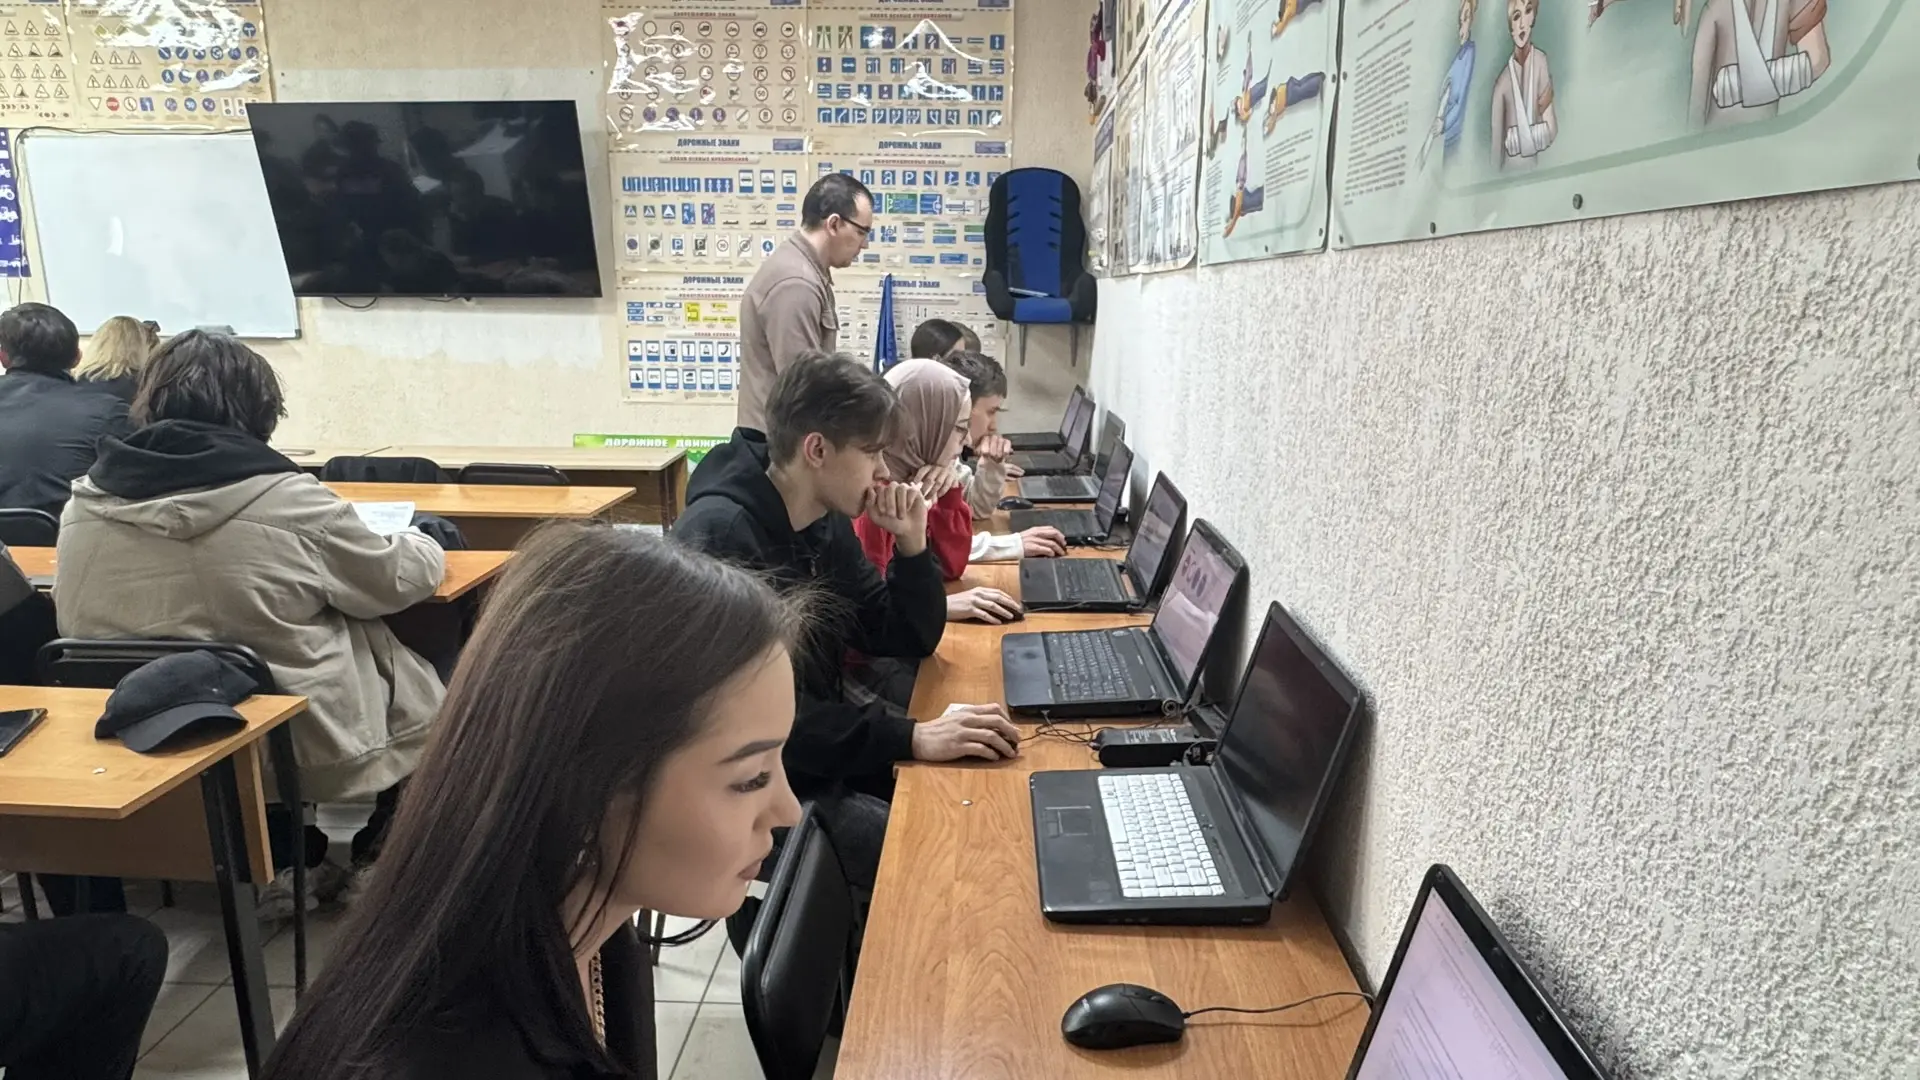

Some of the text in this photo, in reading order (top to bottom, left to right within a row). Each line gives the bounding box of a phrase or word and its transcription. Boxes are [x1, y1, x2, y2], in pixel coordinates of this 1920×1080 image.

[677, 138, 740, 147] ДОРОЖНЫЕ ЗНАКИ
[878, 141, 942, 150] ДОРОЖНЫЕ ЗНАКИ
[683, 276, 744, 285] ДОРОЖНЫЕ ЗНАКИ
[878, 280, 940, 289] ДОЖНЫЕ ЗНАКИ
[604, 438, 669, 448] ДОРОЖНОЕ
